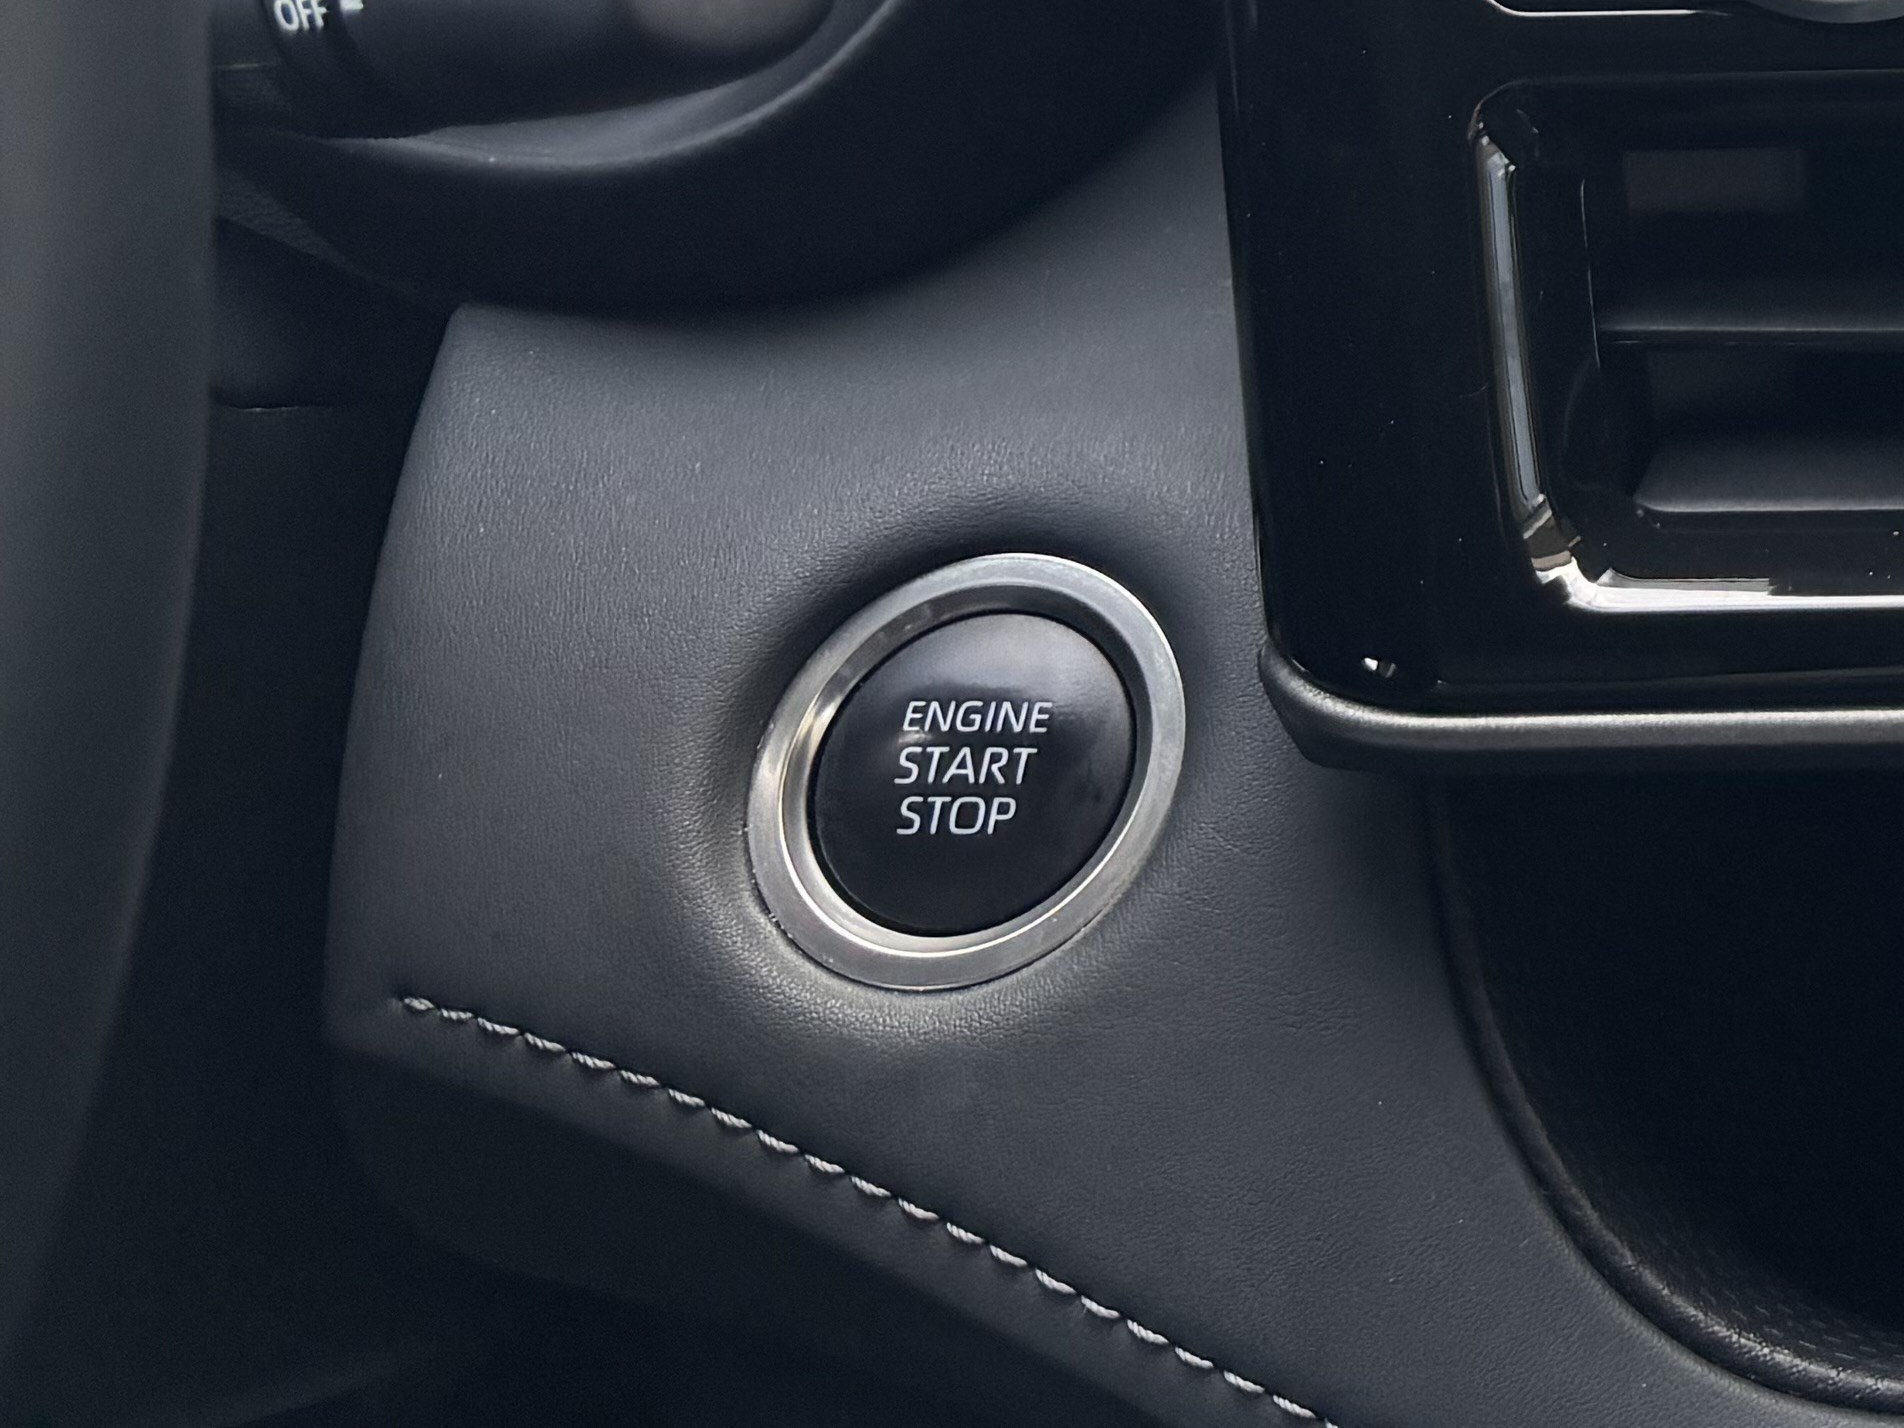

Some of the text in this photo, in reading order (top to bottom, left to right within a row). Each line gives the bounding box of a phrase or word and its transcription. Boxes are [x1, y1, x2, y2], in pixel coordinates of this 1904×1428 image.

[901, 700, 1053, 734] ENGINE
[894, 746, 1038, 785] START
[896, 796, 1017, 836] STOP
